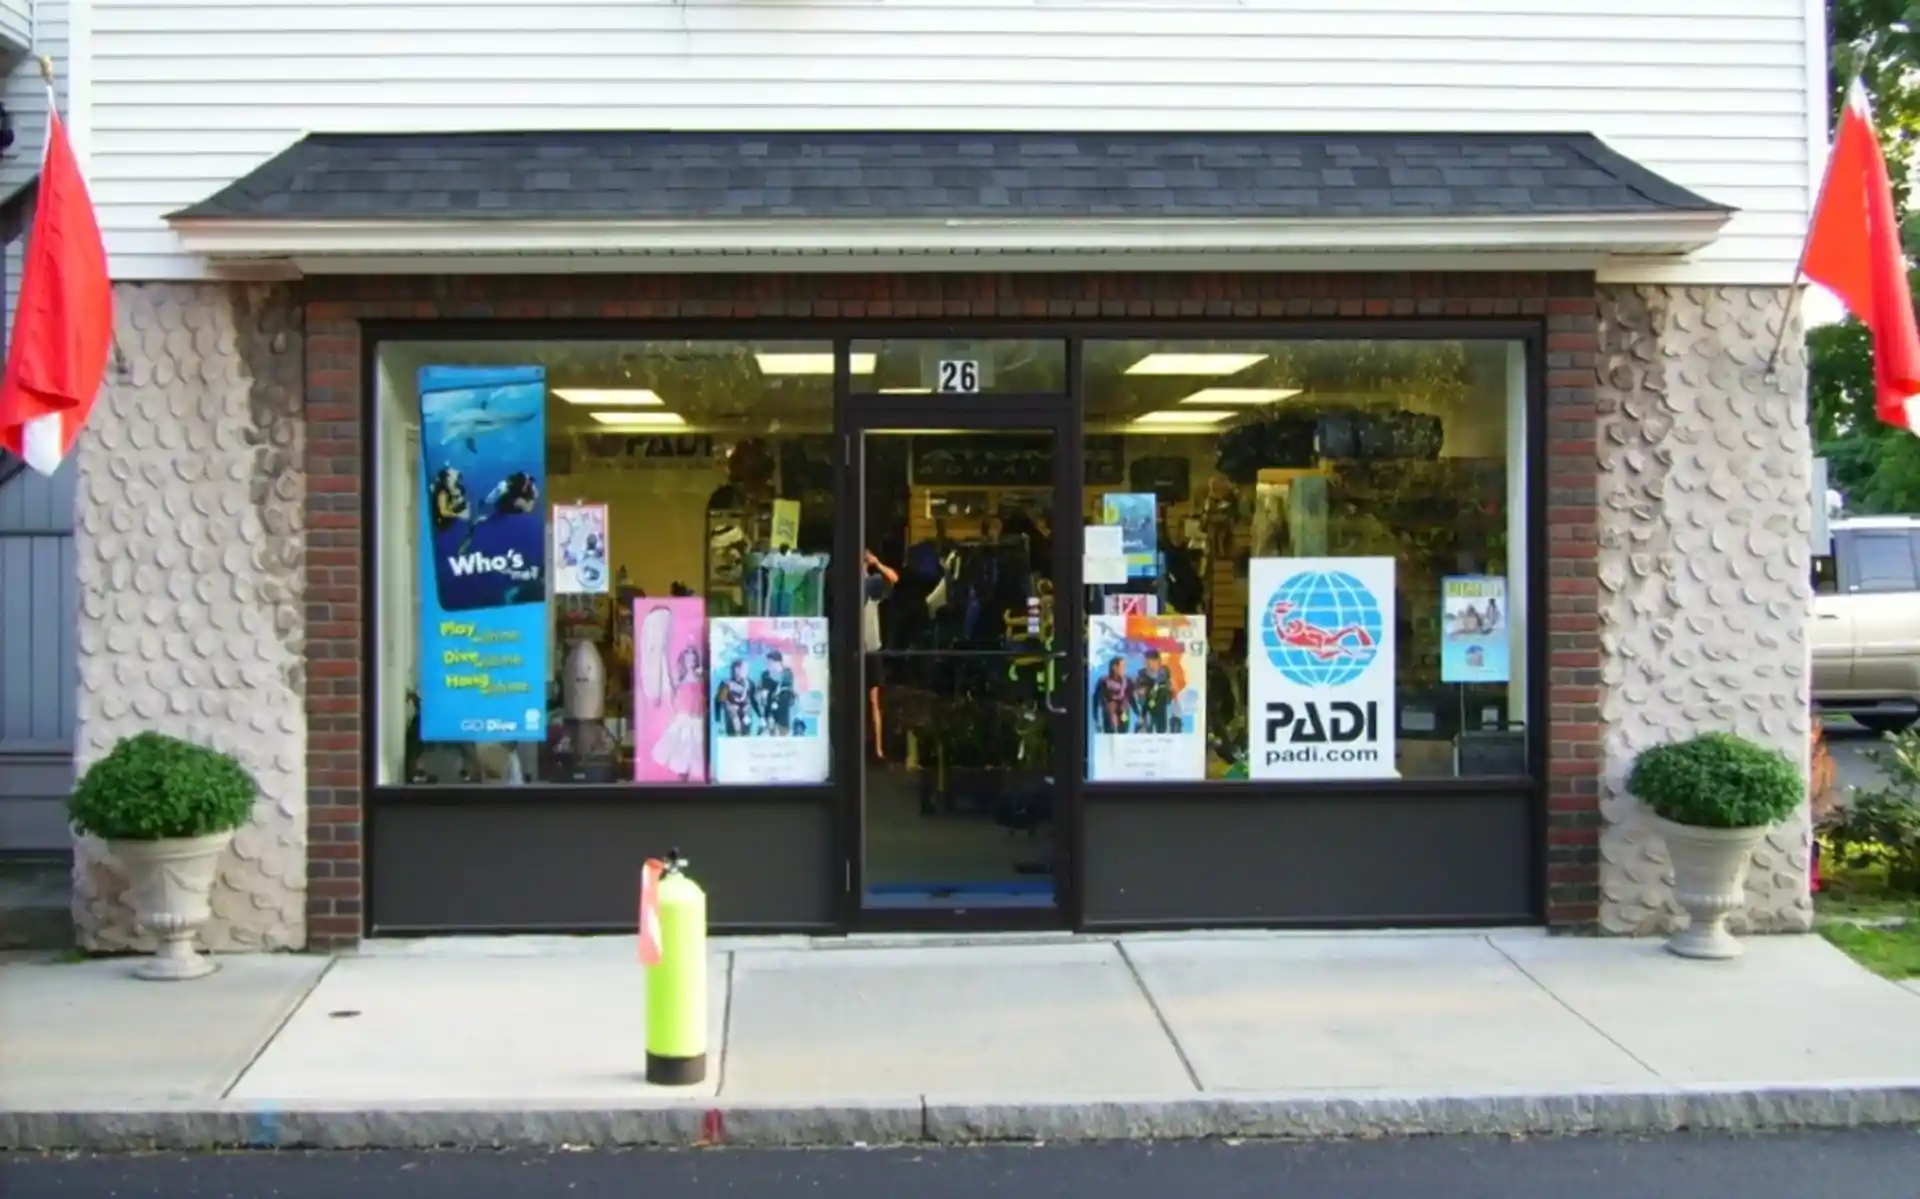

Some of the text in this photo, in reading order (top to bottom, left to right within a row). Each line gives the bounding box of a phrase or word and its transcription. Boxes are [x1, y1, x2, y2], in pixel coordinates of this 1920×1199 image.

[942, 362, 976, 391] 26
[448, 549, 524, 576] Who's
[440, 622, 475, 637] Play
[444, 649, 479, 665] Dive
[446, 674, 490, 689] Hang
[486, 720, 518, 731] Dive
[1265, 700, 1378, 743] PADI
[1265, 746, 1379, 768] padi.com
